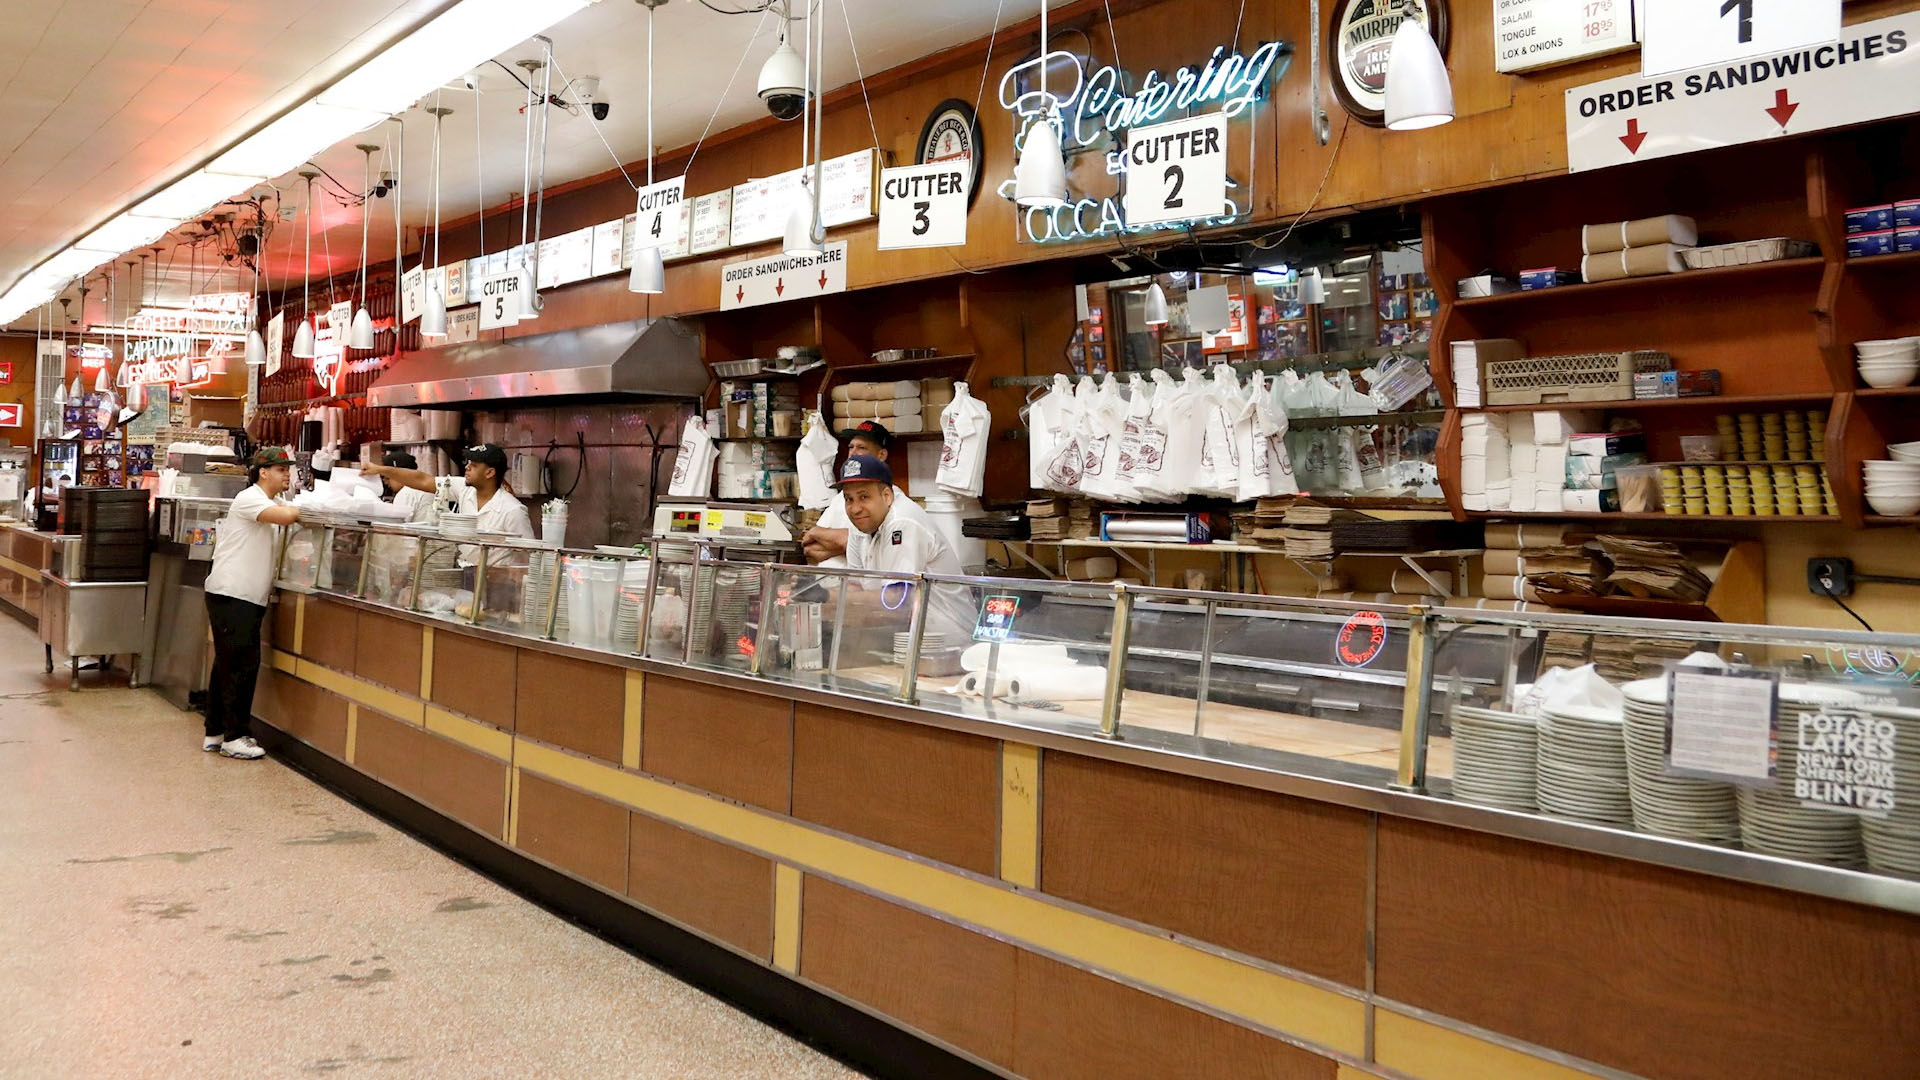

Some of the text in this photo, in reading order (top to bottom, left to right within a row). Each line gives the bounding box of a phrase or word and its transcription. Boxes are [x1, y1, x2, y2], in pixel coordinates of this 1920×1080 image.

[1501, 10, 1533, 26] SALAMI
[1720, 0, 1753, 43] 1
[1350, 16, 1404, 47] MURPH
[1502, 26, 1537, 43] TONGUE
[1367, 51, 1391, 64] IRIS
[1503, 38, 1564, 60] LOX & ONIONS
[1363, 63, 1387, 77] AMB
[1579, 29, 1908, 119] ORDER SANDWICHES
[1074, 40, 1286, 147] Catering
[1131, 126, 1220, 166] CUTTER
[885, 171, 963, 201] CUTTER
[1163, 165, 1185, 210] 2
[639, 185, 680, 213] CUTTER
[651, 211, 662, 239] 4
[912, 200, 931, 237] 3
[726, 249, 842, 282] ORDER SANDWICHES HERE
[402, 272, 422, 293] CUTTER
[483, 276, 519, 297] CUTTER
[332, 307, 350, 321] CUTTER
[410, 292, 416, 312] 6
[495, 297, 504, 320] 5
[134, 316, 184, 332] COFFEE
[338, 322, 344, 341] 7
[128, 359, 179, 384] ESPRESS
[1798, 711, 1896, 740] POTATO
[1797, 729, 1896, 761] LATKES
[1796, 752, 1895, 777] NEW YORK
[1796, 766, 1895, 790] CHEESECAKE
